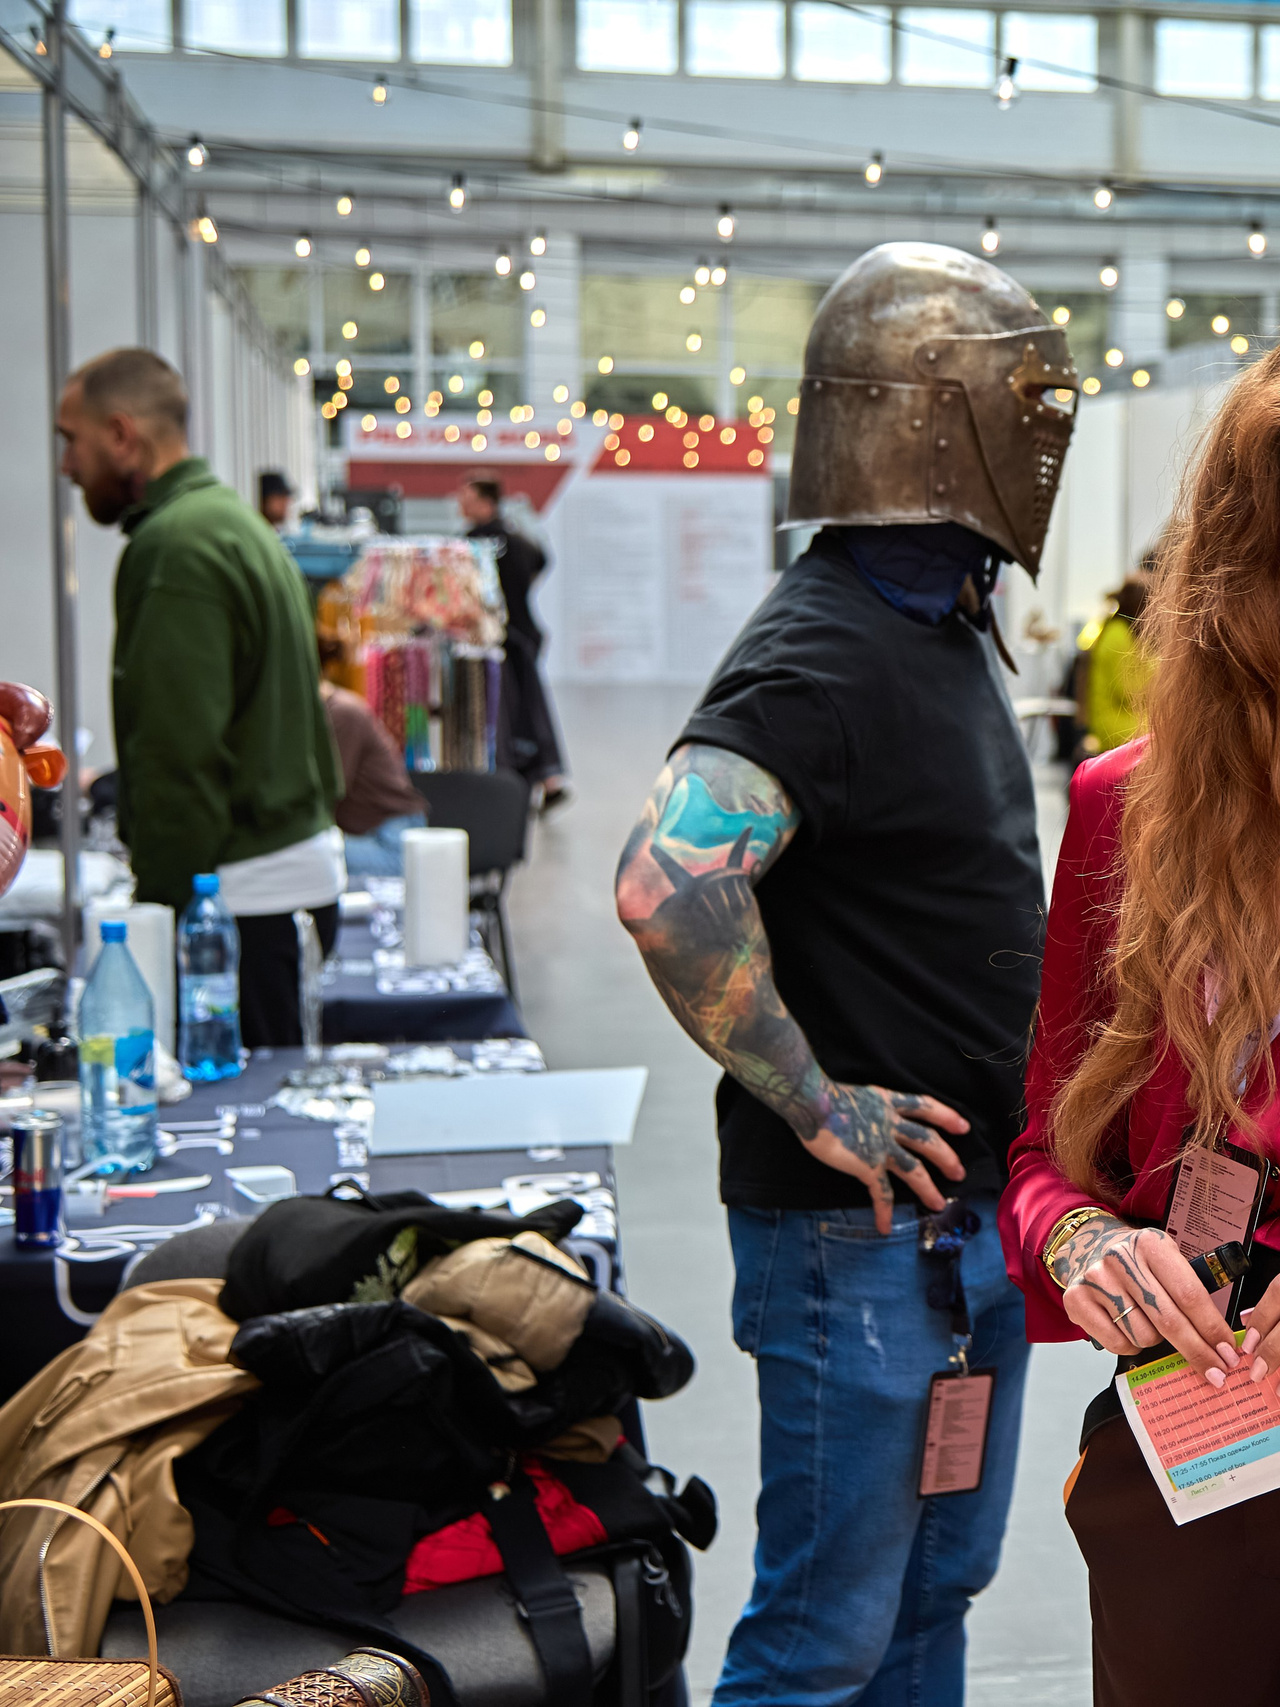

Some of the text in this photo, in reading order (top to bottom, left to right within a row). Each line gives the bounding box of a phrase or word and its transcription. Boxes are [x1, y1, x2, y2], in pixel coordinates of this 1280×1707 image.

[1236, 1392, 1263, 1406] реализм
[1241, 1405, 1269, 1419] графика
[1172, 1467, 1189, 1478] 17:25
[1208, 1454, 1227, 1465] Показ
[1227, 1444, 1251, 1457] одежды
